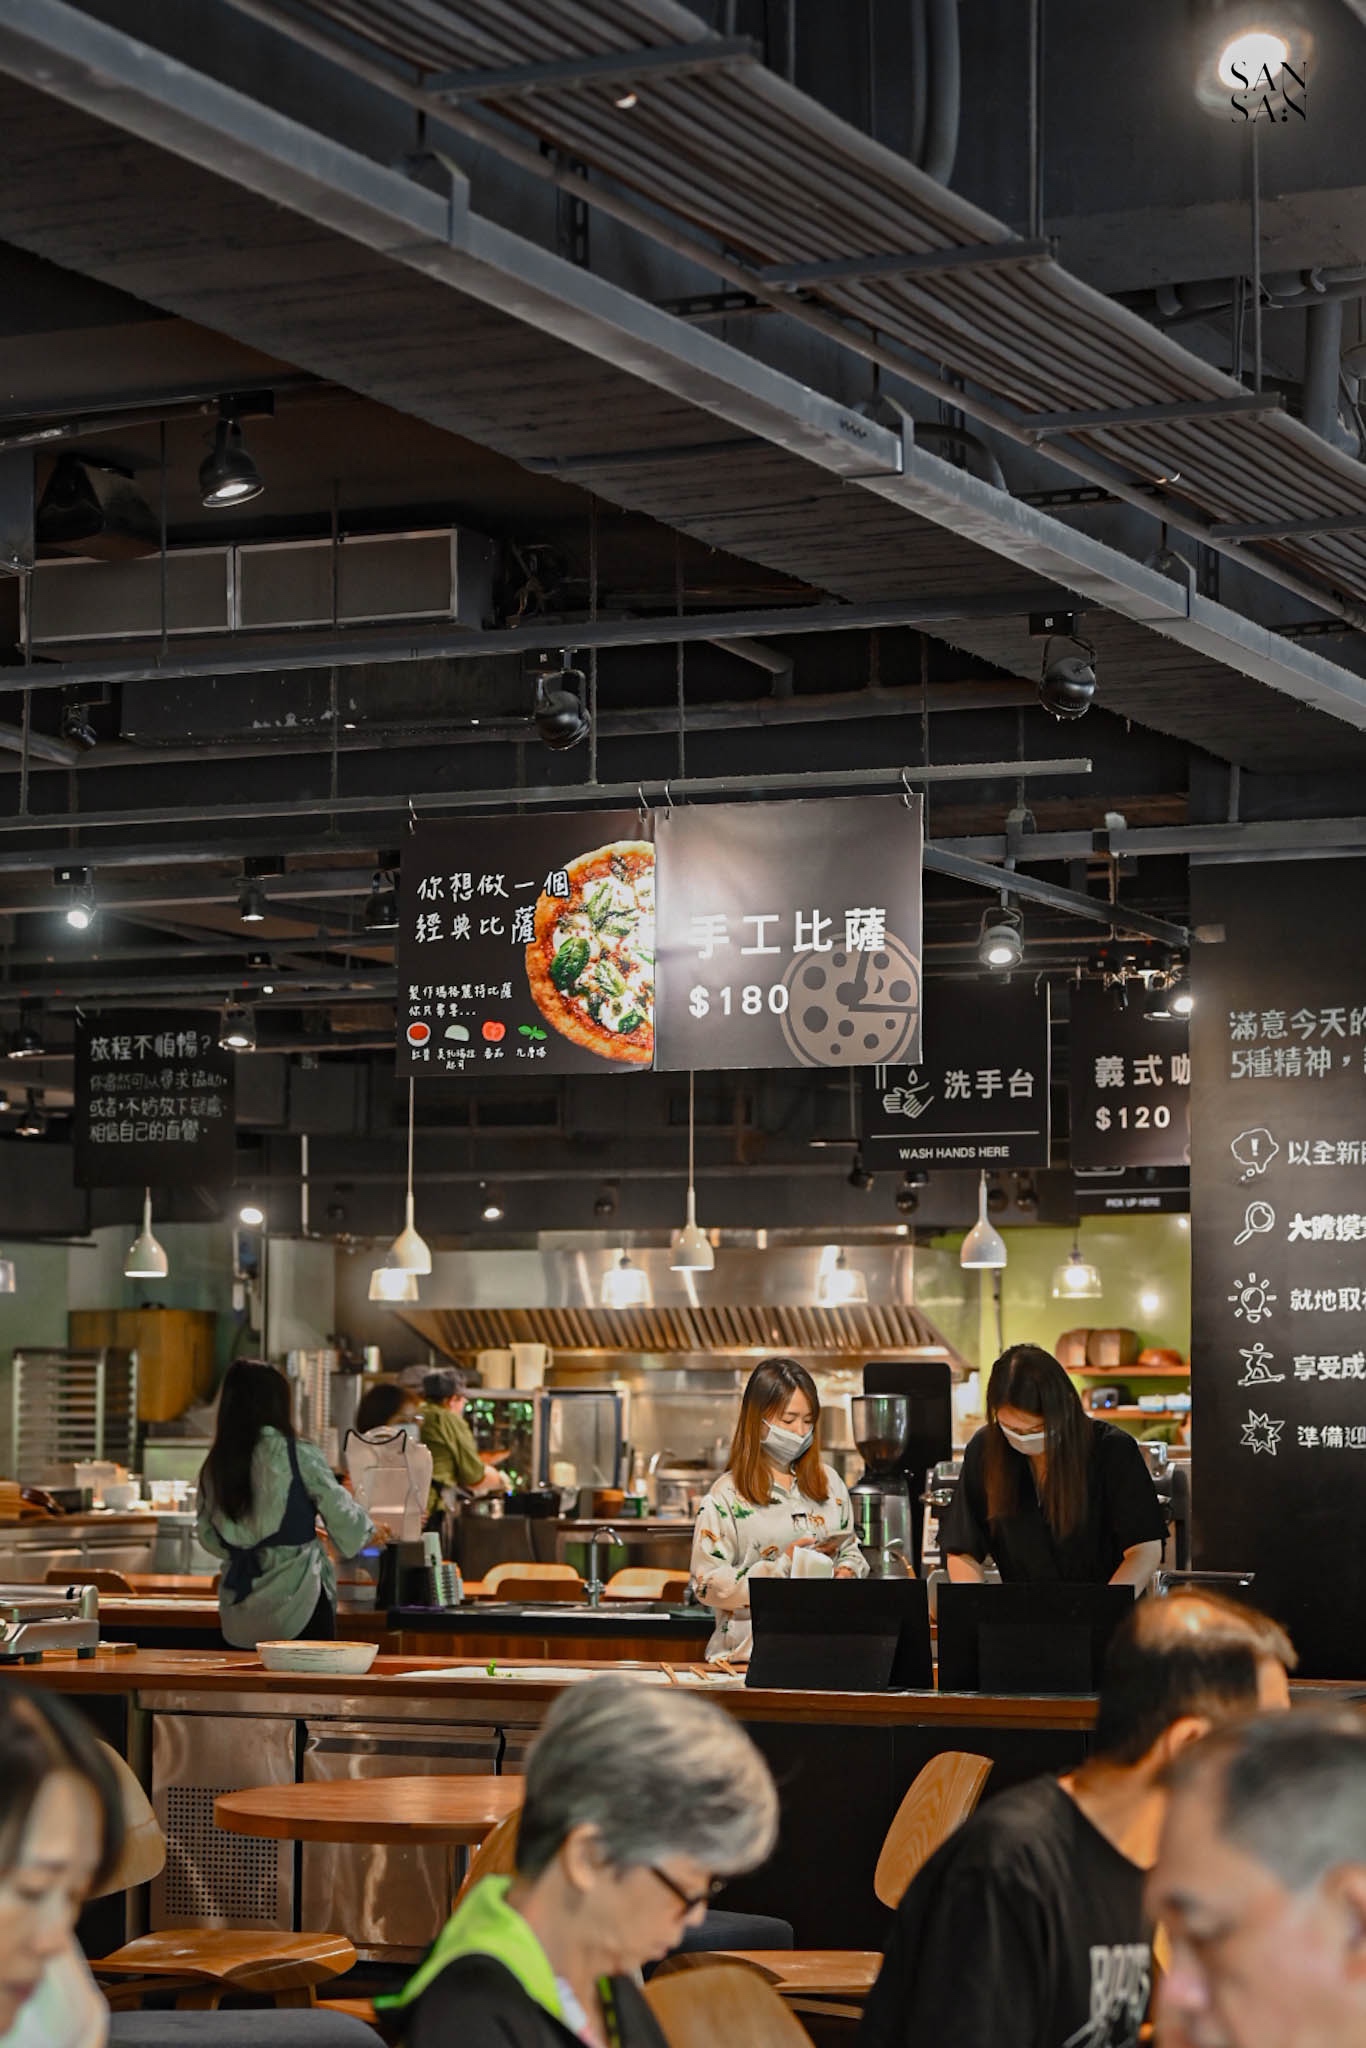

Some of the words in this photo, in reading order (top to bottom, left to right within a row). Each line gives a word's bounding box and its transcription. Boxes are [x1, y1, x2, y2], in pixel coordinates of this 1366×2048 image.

[416, 870, 570, 903] 你想做一個
[415, 906, 537, 945] 經典比薩
[689, 908, 887, 959] 手工比薩
[689, 984, 789, 1018] $180
[1229, 1045, 1366, 1079] 5種精神，
[943, 1068, 1035, 1100] 洗手台
[1095, 1105, 1170, 1131] $120
[899, 1147, 933, 1160] WASH
[936, 1146, 976, 1159] HANDS
[978, 1145, 1010, 1158] HERE
[1290, 1287, 1366, 1312] 就地取
